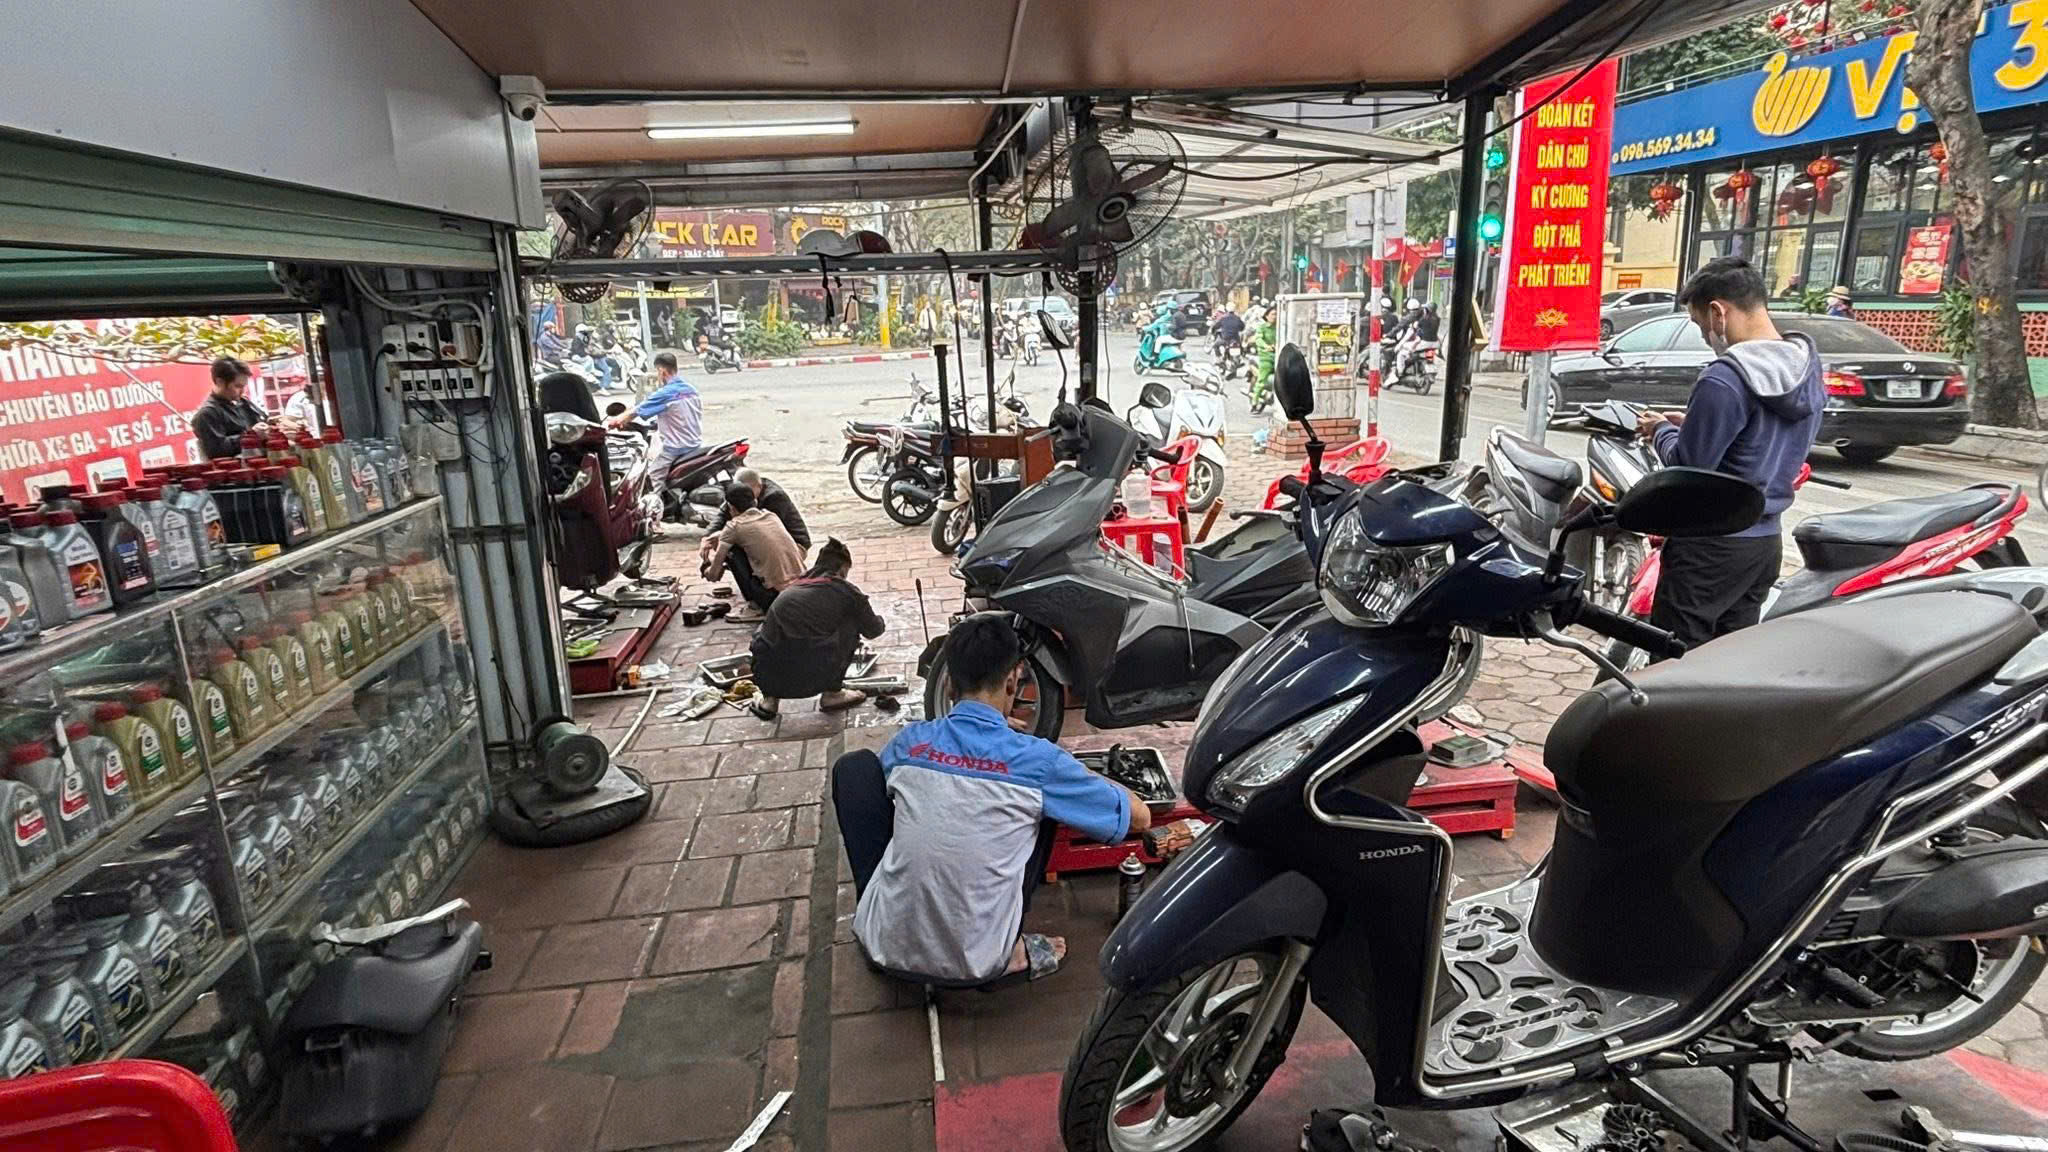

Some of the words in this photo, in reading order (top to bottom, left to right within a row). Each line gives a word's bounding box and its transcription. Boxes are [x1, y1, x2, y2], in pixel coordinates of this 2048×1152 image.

[1537, 100, 1572, 128] ĐOÀN
[1572, 96, 1595, 128] KẾT
[1537, 139, 1563, 168] DÂN
[1566, 137, 1589, 168] CHỦ
[1620, 126, 1716, 163] 098.569.34.34
[1531, 177, 1547, 209] KỶ
[1550, 183, 1589, 209] CƯƠNG
[702, 223, 757, 246] CAR
[1533, 221, 1557, 252] ĐỘT
[1559, 219, 1581, 248] PHÁ
[1519, 258, 1550, 287] PHÁT
[1553, 255, 1591, 286] TRIỂN!
[71, 383, 110, 414] BẢO
[42, 435, 71, 462] XE
[70, 430, 97, 457] GA
[106, 423, 132, 448] XE
[131, 411, 154, 444] SỐ
[927, 750, 1009, 774] HONDA
[1358, 844, 1425, 860] HONDA
